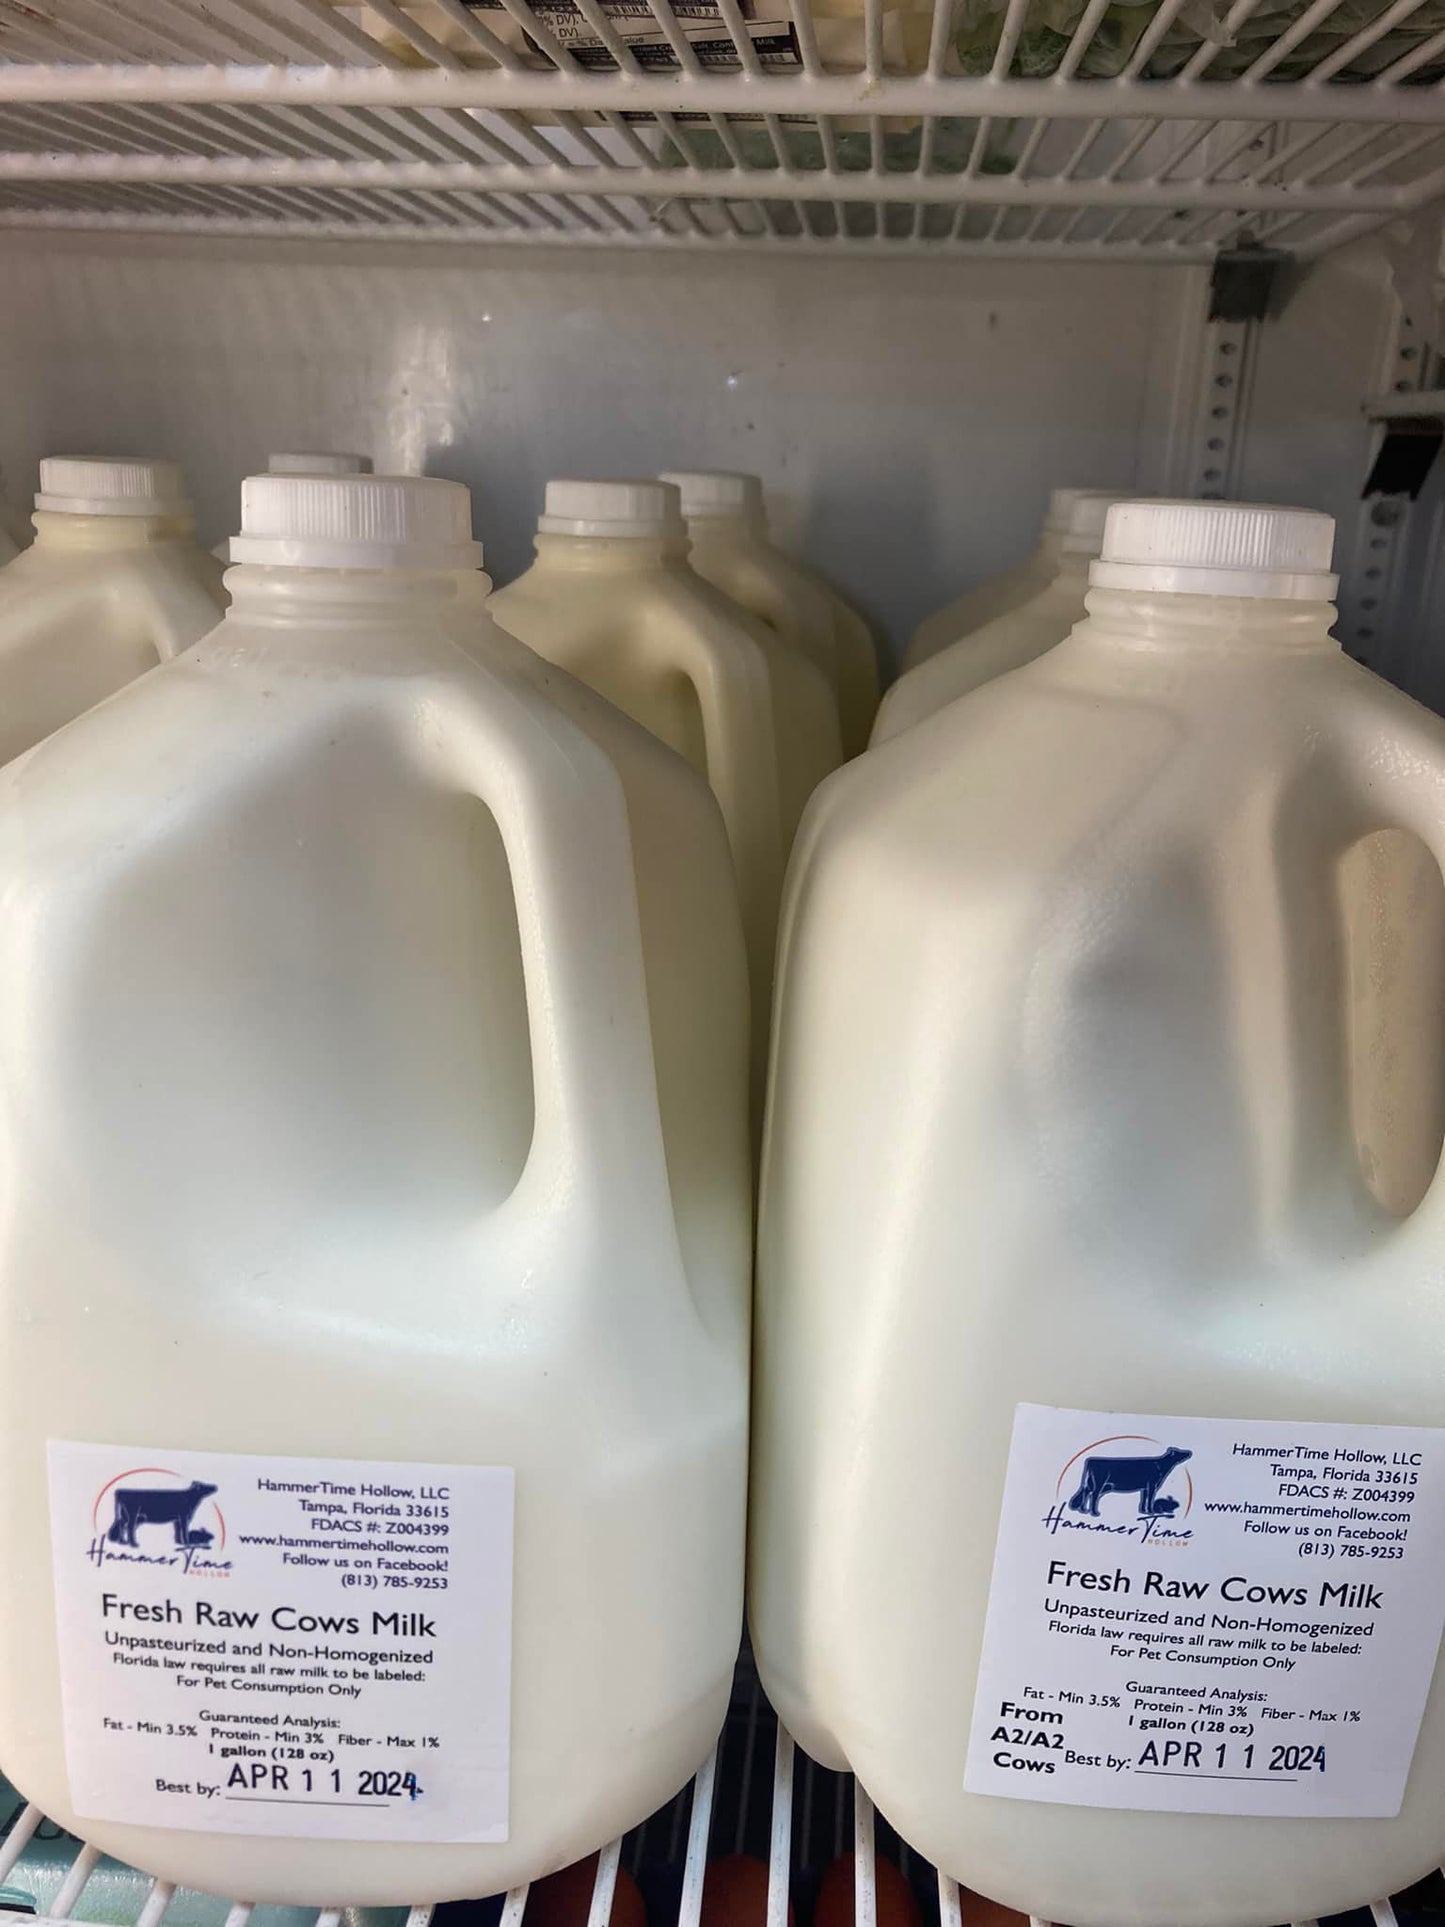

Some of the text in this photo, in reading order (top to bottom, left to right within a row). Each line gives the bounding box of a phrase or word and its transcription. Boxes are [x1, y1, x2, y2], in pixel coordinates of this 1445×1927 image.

[1232, 1443, 1422, 1466] HammerTime Hollow, LLC
[1270, 1464, 1418, 1484] Tampa, Florida 33615
[258, 1478, 450, 1500] HammerTime Hollow, LLC
[1279, 1484, 1414, 1503] FDACS #: Z004399
[298, 1499, 449, 1518] Tampa, Florida 33615
[1204, 1501, 1410, 1522] www.hammertimehollow.com
[311, 1518, 450, 1536] FDACS #: Z004399
[1244, 1520, 1408, 1541] Follow us on Facebook!
[239, 1534, 449, 1554] www.hammertimehollow.com
[1299, 1542, 1404, 1559] (813) 785-9253
[283, 1552, 448, 1572] Follow us on Facebook!
[341, 1574, 448, 1590] (813) 785-9253
[1048, 1560, 1384, 1608] Fresh Raw Cows Milk
[102, 1593, 437, 1638] Fresh Raw Cows Milk
[1045, 1598, 1374, 1638] Unpasteurized and Non-Homogenized
[105, 1630, 433, 1666] Unpasteurized and Non-Homogenized
[1049, 1620, 1362, 1654] Florida law requires all raw milk to be labeled:
[113, 1652, 426, 1682] Florida law requires all raw milk to be labeled:
[1110, 1645, 1296, 1672] For Pet Consumption Only
[177, 1674, 362, 1699] For Pet Consumption Only
[1126, 1681, 1268, 1703] Guaranteed Analysis:
[1000, 1702, 1063, 1724] From
[1024, 1686, 1044, 1700] Fat
[1059, 1691, 1084, 1704] Min
[1089, 1694, 1120, 1708] 3.5%
[1134, 1699, 1183, 1713] Protein
[1198, 1704, 1223, 1716] Min
[1228, 1706, 1247, 1717] 3%
[1261, 1708, 1296, 1719] Fiber
[1309, 1710, 1337, 1721] Max
[1344, 1711, 1360, 1722] 1%
[198, 1709, 340, 1731] Guaranteed Analysis:
[1139, 1718, 1186, 1730] gallon
[1191, 1720, 1225, 1734] (128
[1230, 1724, 1254, 1738] oz)
[103, 1717, 124, 1730] Fat
[137, 1721, 162, 1734] Min
[166, 1724, 198, 1736] 3.5%
[211, 1727, 260, 1741] Protein
[274, 1731, 300, 1743] Min
[304, 1732, 324, 1744] 3%
[338, 1734, 373, 1746] Fiber
[387, 1736, 416, 1748] Max
[422, 1736, 440, 1748] 1%
[990, 1726, 1064, 1749] A2/A2
[220, 1745, 266, 1758] gallon
[271, 1747, 305, 1762] (128
[309, 1749, 334, 1764] oz)
[993, 1752, 1055, 1774] Cows
[1065, 1750, 1101, 1766] Best
[1106, 1754, 1131, 1772] by:
[1138, 1740, 1202, 1768] APR
[1268, 1746, 1325, 1772] 2024
[156, 1778, 192, 1794] Best
[196, 1782, 220, 1799] by:
[227, 1762, 289, 1791] APR
[358, 1770, 417, 1799] 2024
